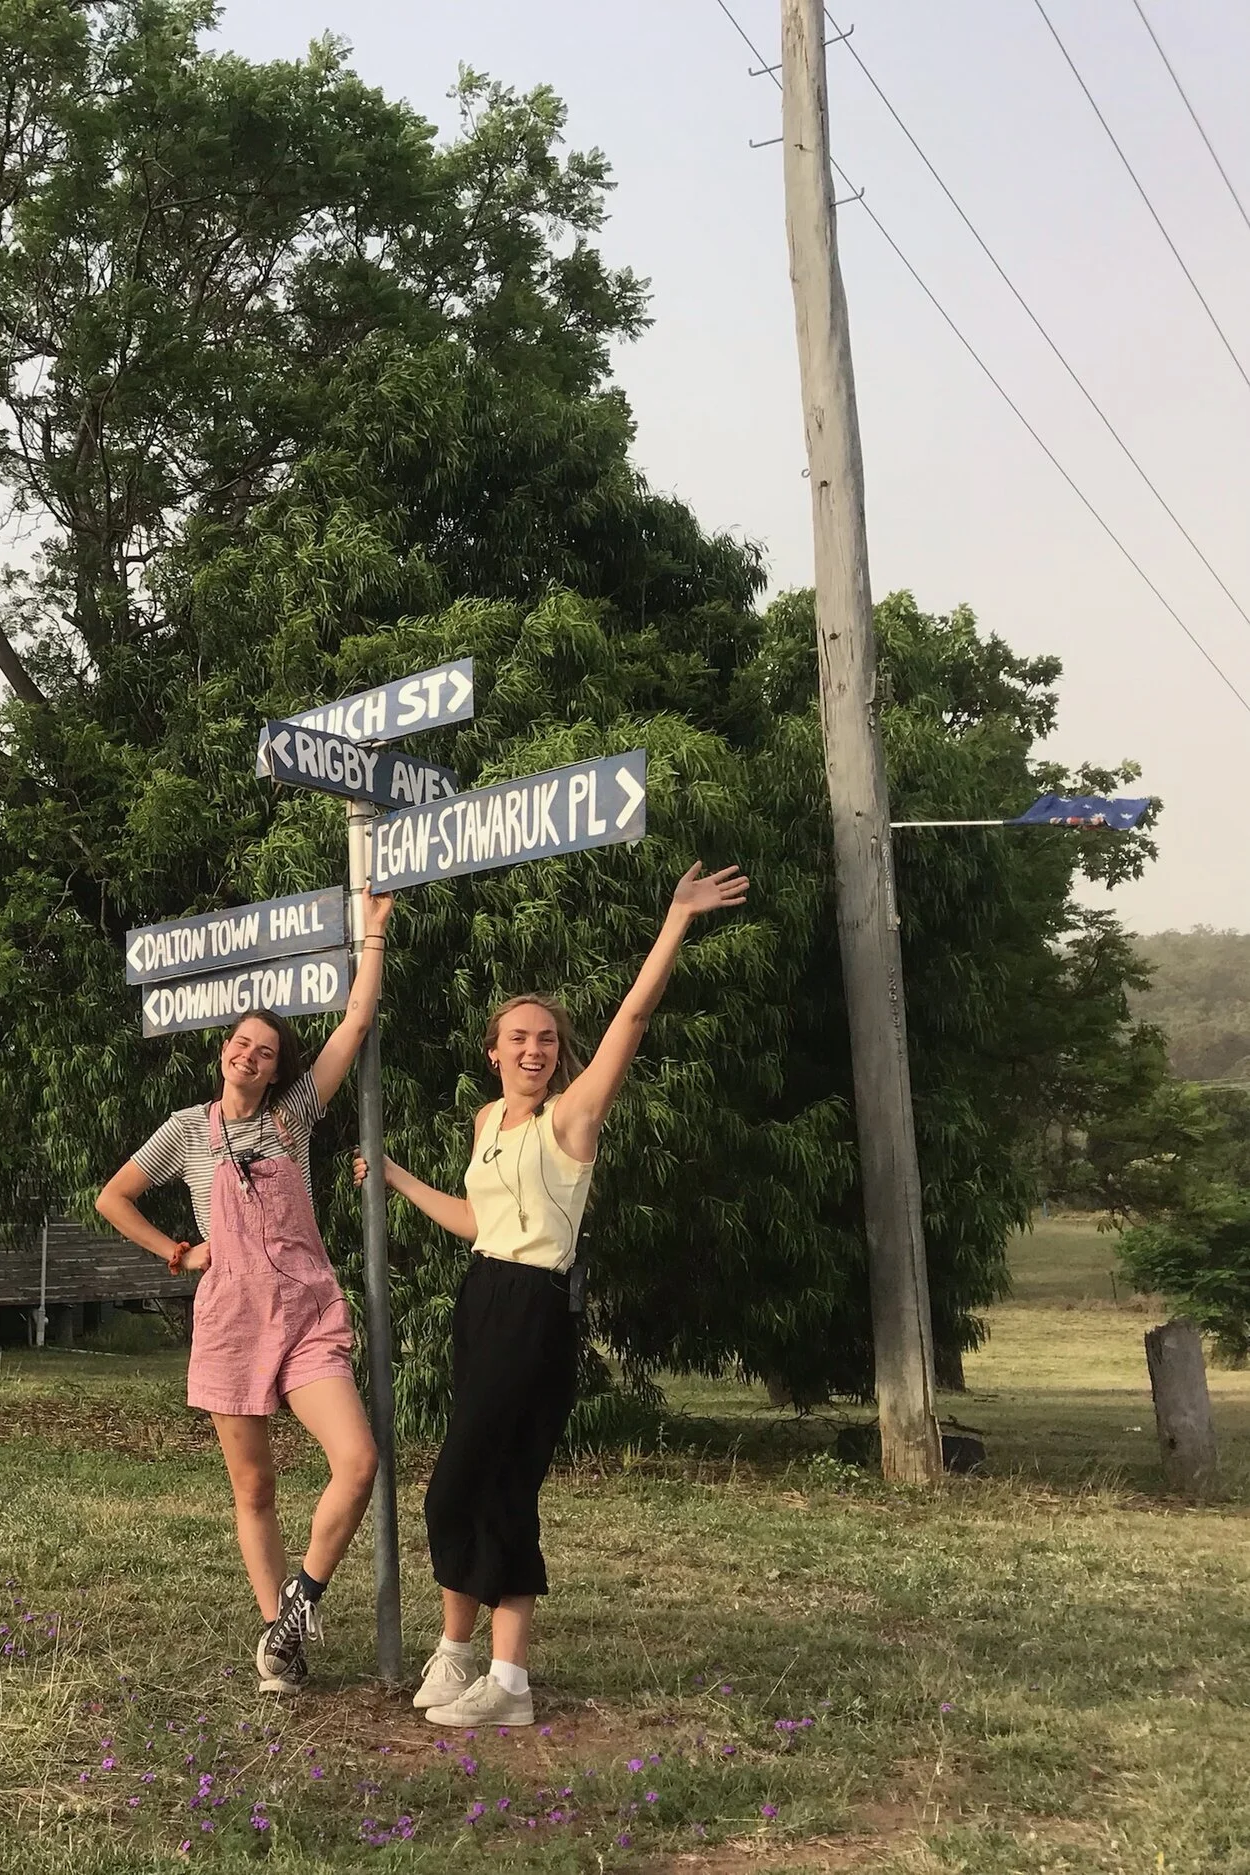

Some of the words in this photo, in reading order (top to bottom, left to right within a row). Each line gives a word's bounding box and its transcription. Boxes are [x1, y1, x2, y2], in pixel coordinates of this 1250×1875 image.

[396, 671, 448, 726] ST
[294, 731, 379, 793] RIGBY
[390, 760, 440, 806] AVE
[376, 779, 561, 882] EGAN-STAWARUK
[568, 770, 607, 842] PL
[144, 926, 205, 972] DALTON
[208, 911, 260, 957] TOWN
[269, 901, 324, 941] HALL
[301, 962, 339, 1005] RD
